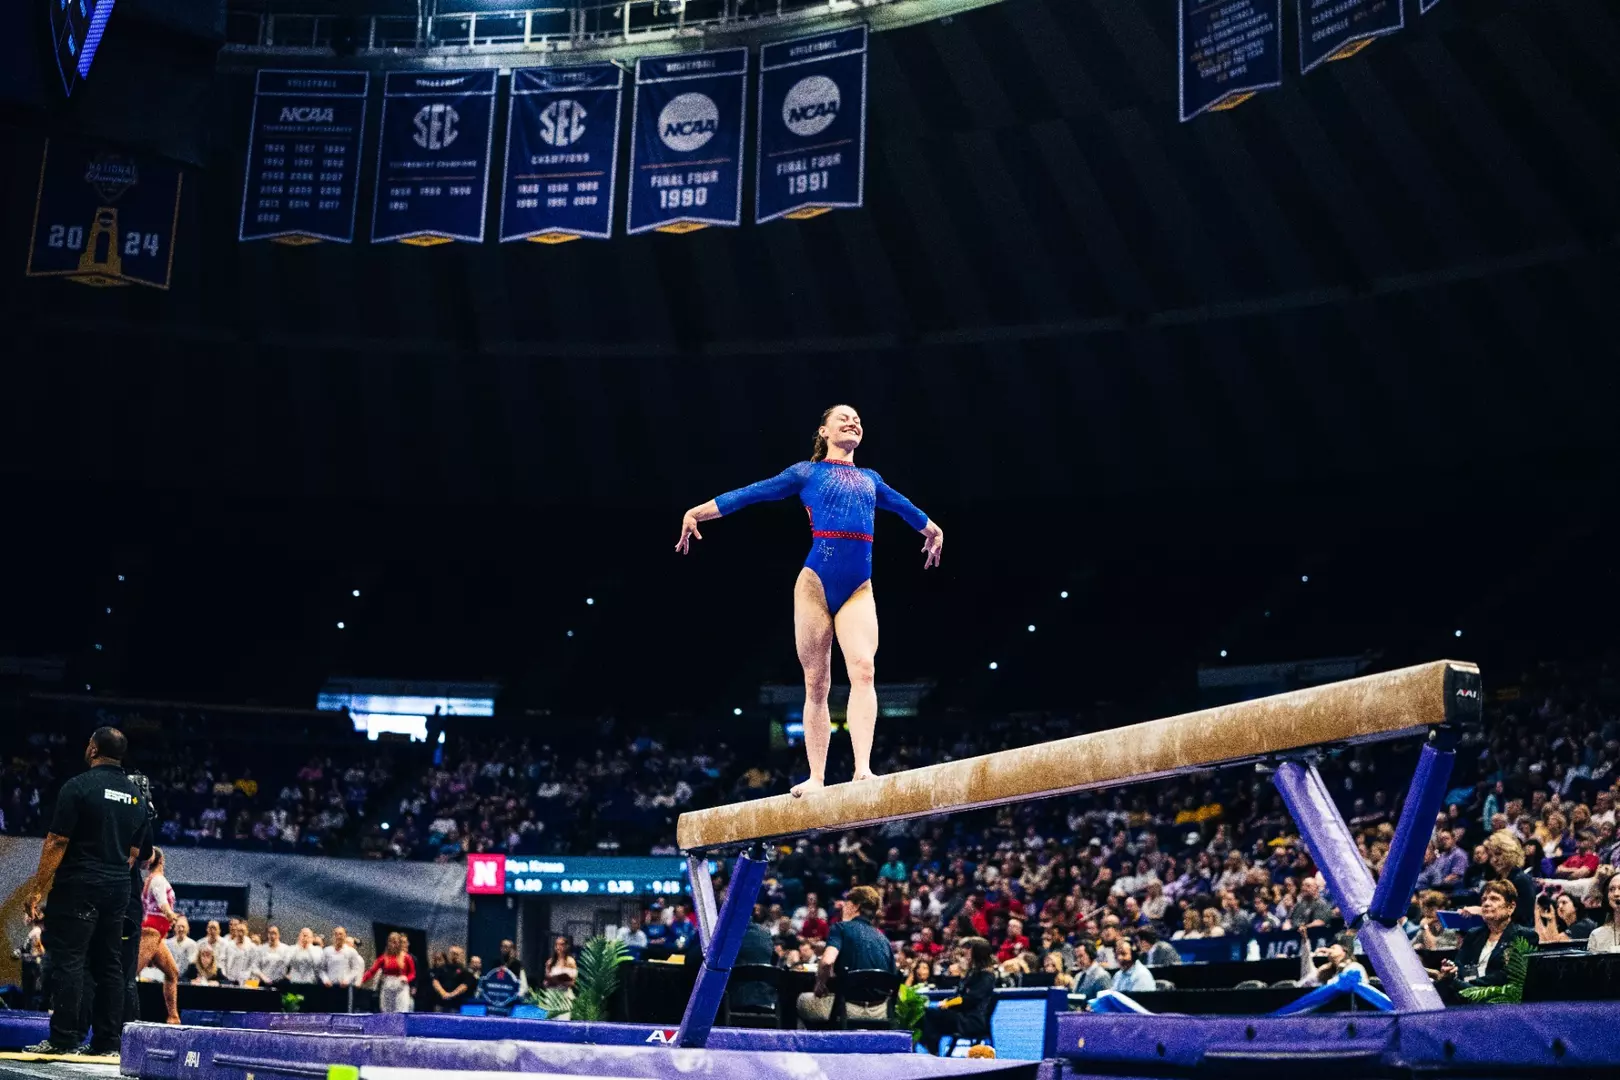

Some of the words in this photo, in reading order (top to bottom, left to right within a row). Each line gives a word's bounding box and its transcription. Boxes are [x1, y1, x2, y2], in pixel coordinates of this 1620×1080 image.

[279, 107, 334, 122] NCAA
[539, 100, 588, 146] SEC
[788, 100, 838, 123] NCAA
[413, 104, 460, 150] SEC
[664, 120, 715, 137] NCAA
[531, 152, 590, 165] CHAMPIONS
[776, 157, 807, 176] FINAL
[811, 153, 841, 169] FOUR
[651, 173, 684, 188] FINAL
[687, 170, 719, 185] FOUR
[788, 170, 828, 195] 1991
[660, 186, 708, 209] 1990
[48, 223, 83, 250] 20
[124, 231, 160, 257] 24
[472, 861, 497, 887] N
